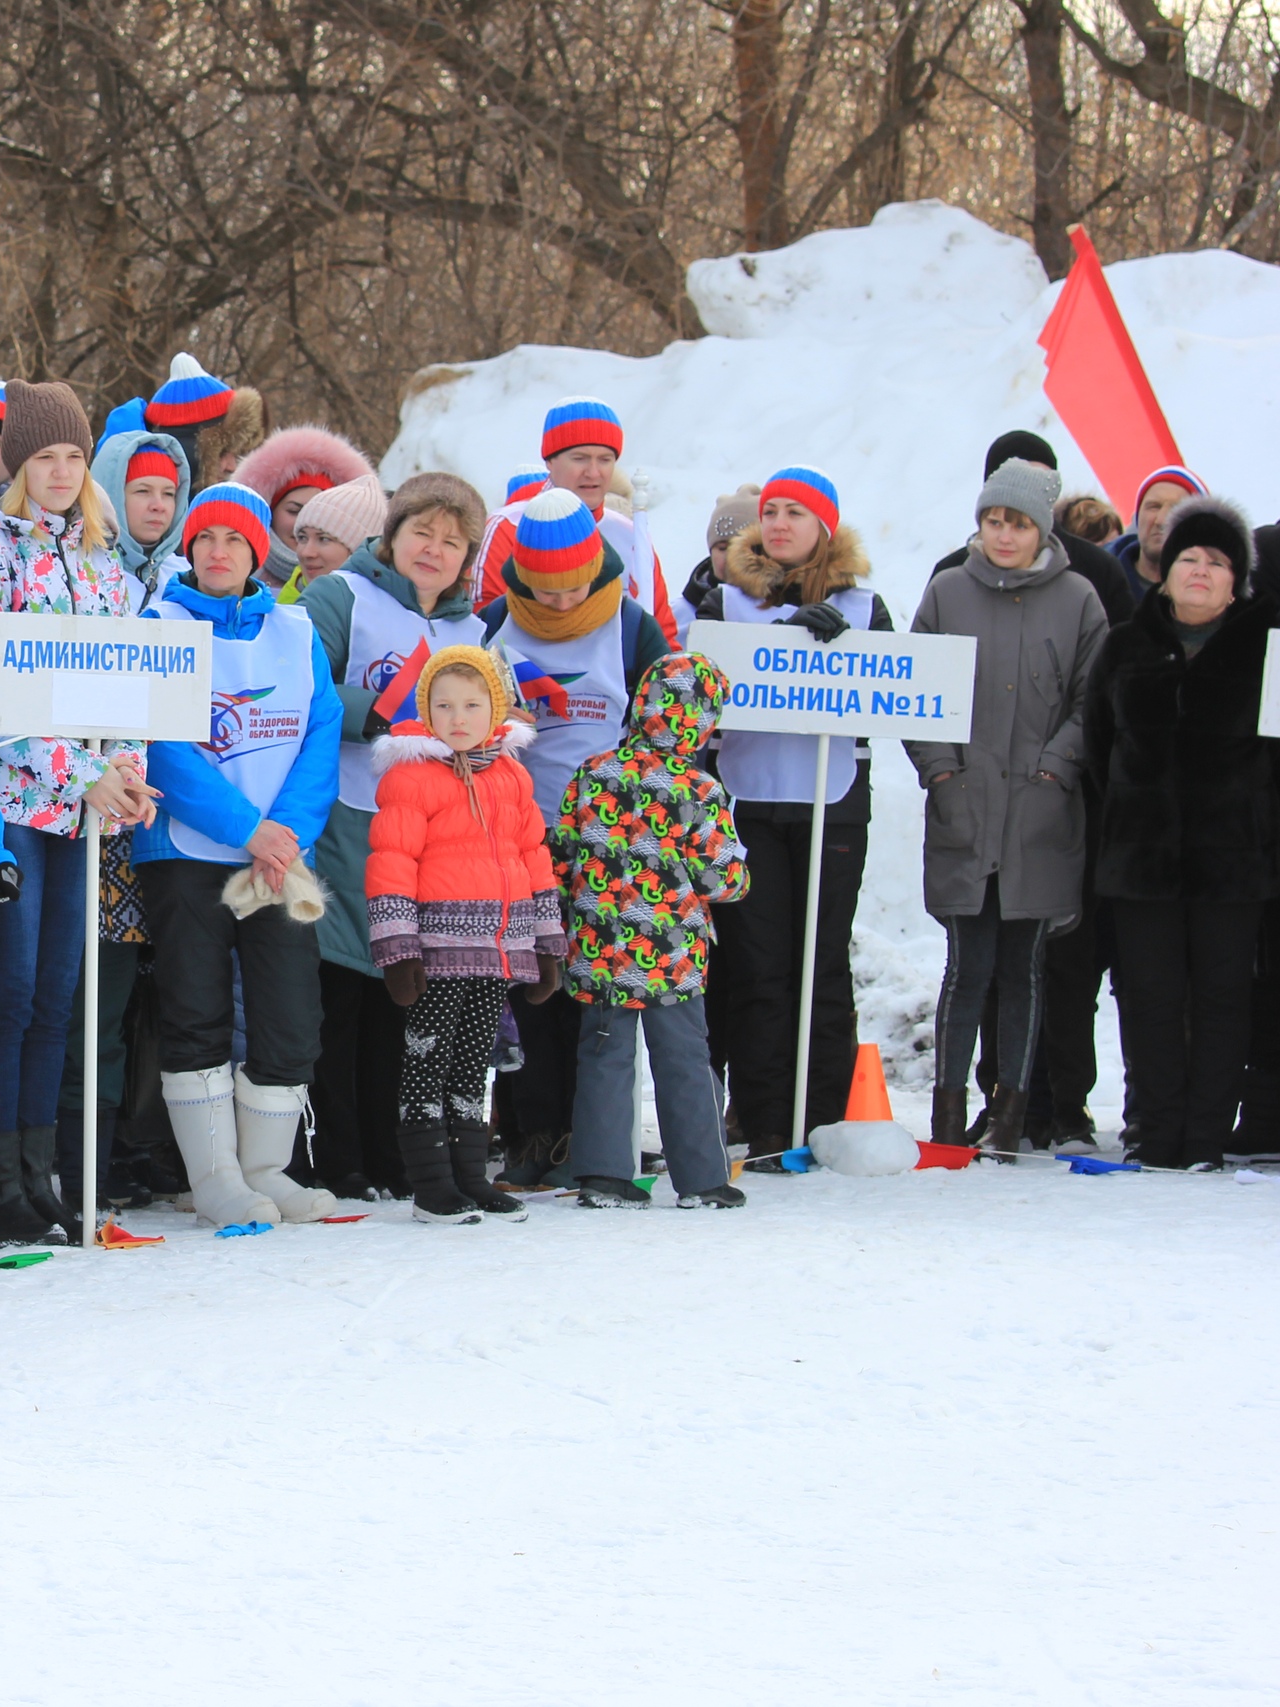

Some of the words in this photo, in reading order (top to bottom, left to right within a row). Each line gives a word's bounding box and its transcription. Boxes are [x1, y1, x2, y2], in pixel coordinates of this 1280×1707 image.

[3, 640, 195, 678] АДМИНИСТРАЦИЯ
[753, 647, 913, 680] ОБЛАСТНАЯ
[722, 683, 861, 717] ОЛЬНИЦА
[871, 691, 944, 718] №11
[249, 708, 261, 716] МЫ
[249, 719, 258, 727] ЗА
[259, 716, 299, 728] ЗДОРОВЫЙ
[249, 730, 274, 738] ОБРАЗ
[276, 729, 299, 737] ЖИЗНИ
